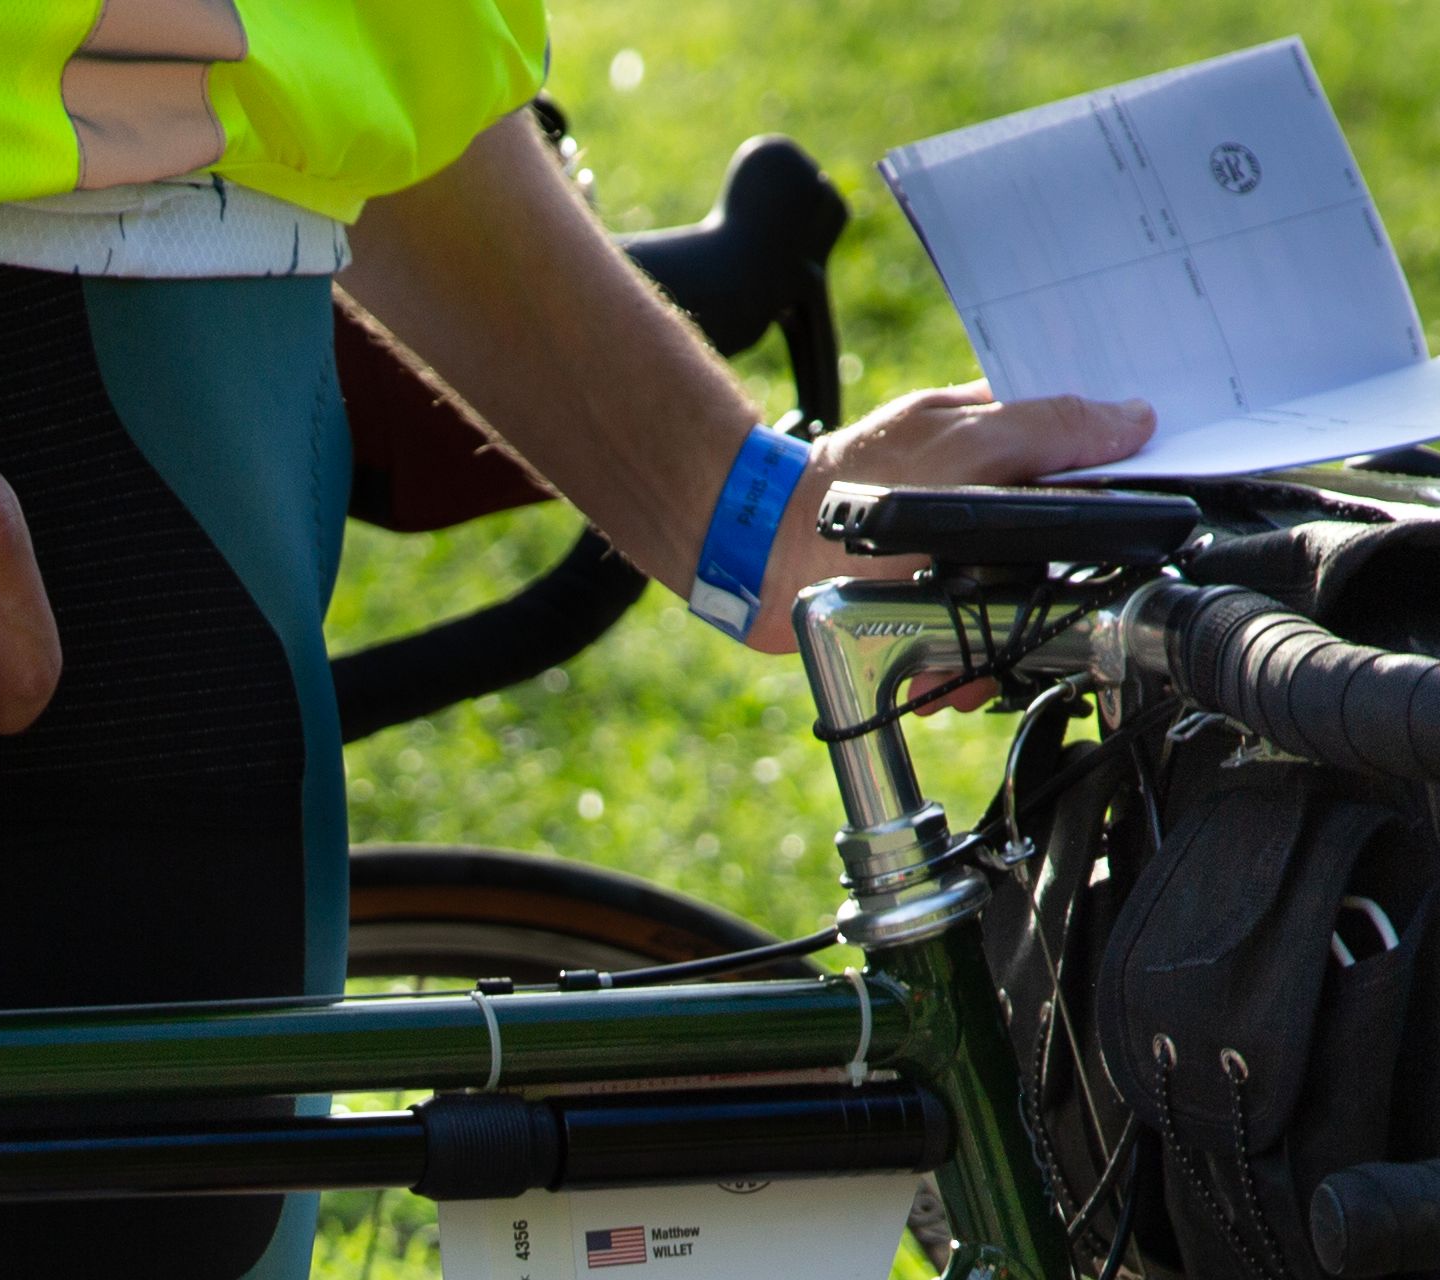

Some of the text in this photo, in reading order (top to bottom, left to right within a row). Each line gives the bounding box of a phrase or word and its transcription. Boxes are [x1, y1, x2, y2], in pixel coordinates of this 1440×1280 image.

[512, 1220, 530, 1261] 4356
[651, 1224, 700, 1241] Matthew
[652, 1243, 693, 1259] WILLET
